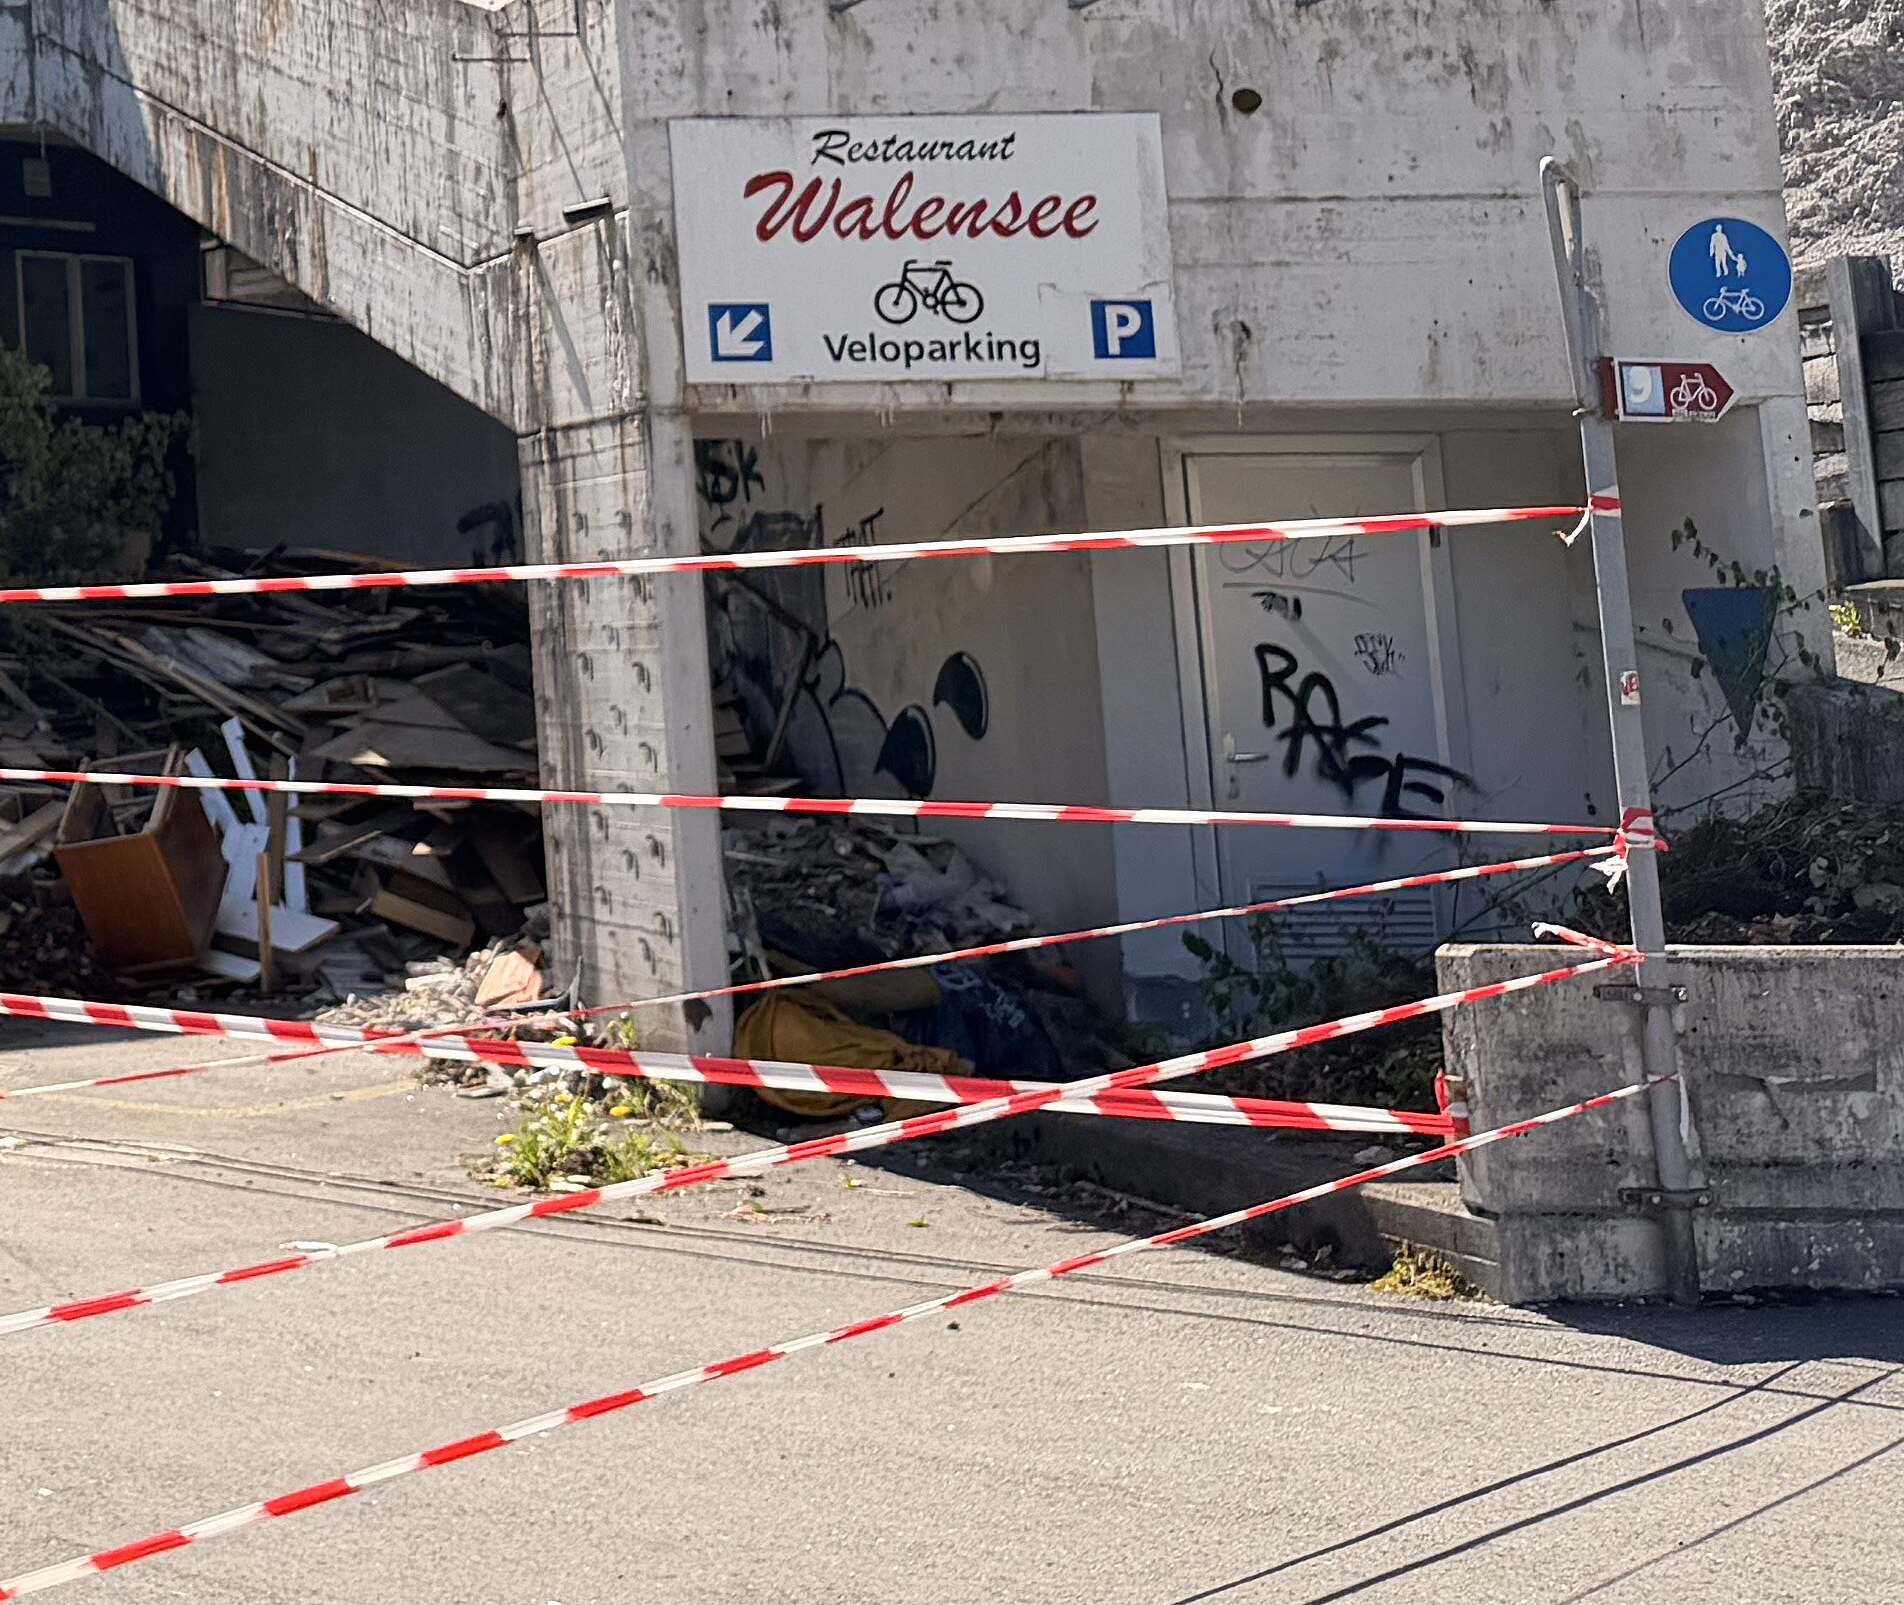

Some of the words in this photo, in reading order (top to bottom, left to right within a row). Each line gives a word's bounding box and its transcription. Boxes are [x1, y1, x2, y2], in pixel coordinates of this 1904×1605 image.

[810, 129, 1017, 167] Restaurant
[743, 171, 1101, 244] Walensee
[1104, 304, 1141, 355] P
[823, 332, 1042, 368] Veloparking
[1628, 365, 1653, 404] 9
